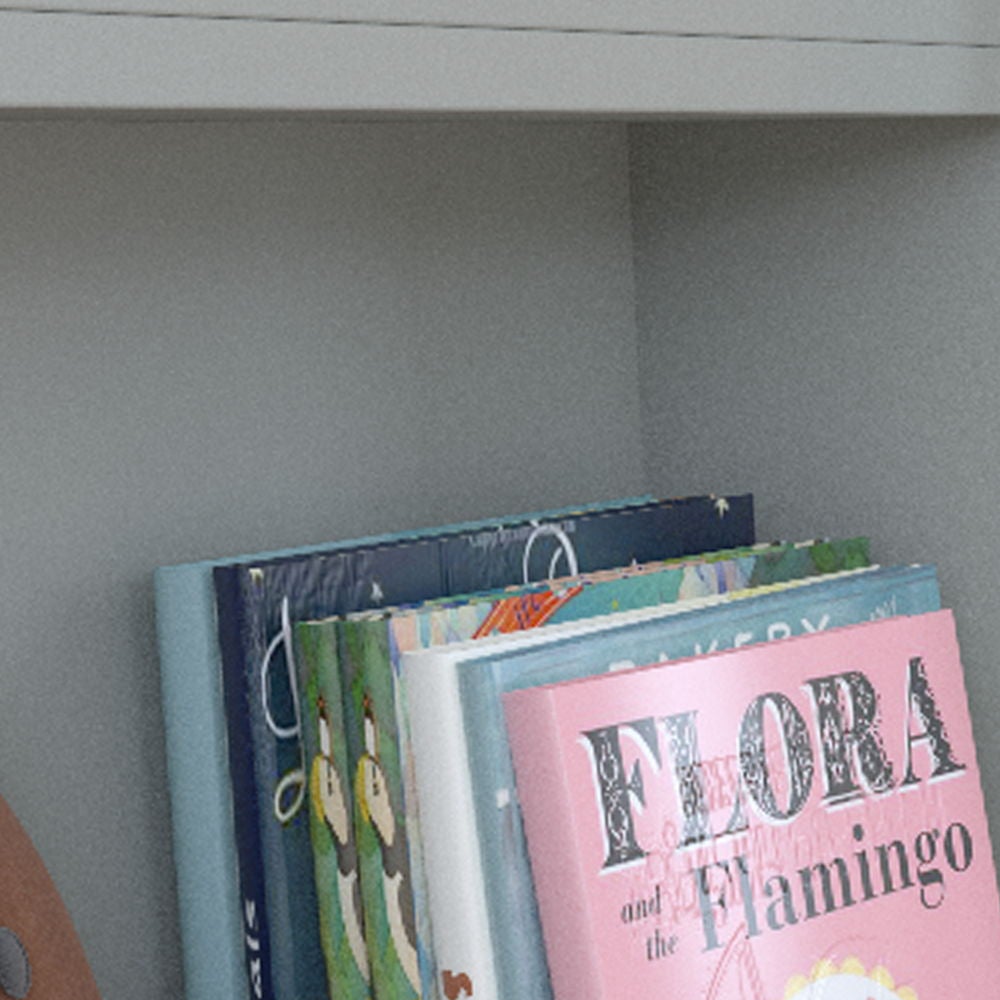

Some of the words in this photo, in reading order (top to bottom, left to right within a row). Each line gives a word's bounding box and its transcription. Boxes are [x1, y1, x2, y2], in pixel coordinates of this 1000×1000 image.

[578, 656, 967, 874] FLORA
[620, 886, 662, 925] and
[692, 822, 975, 953] Flamingo
[646, 929, 680, 961] the
